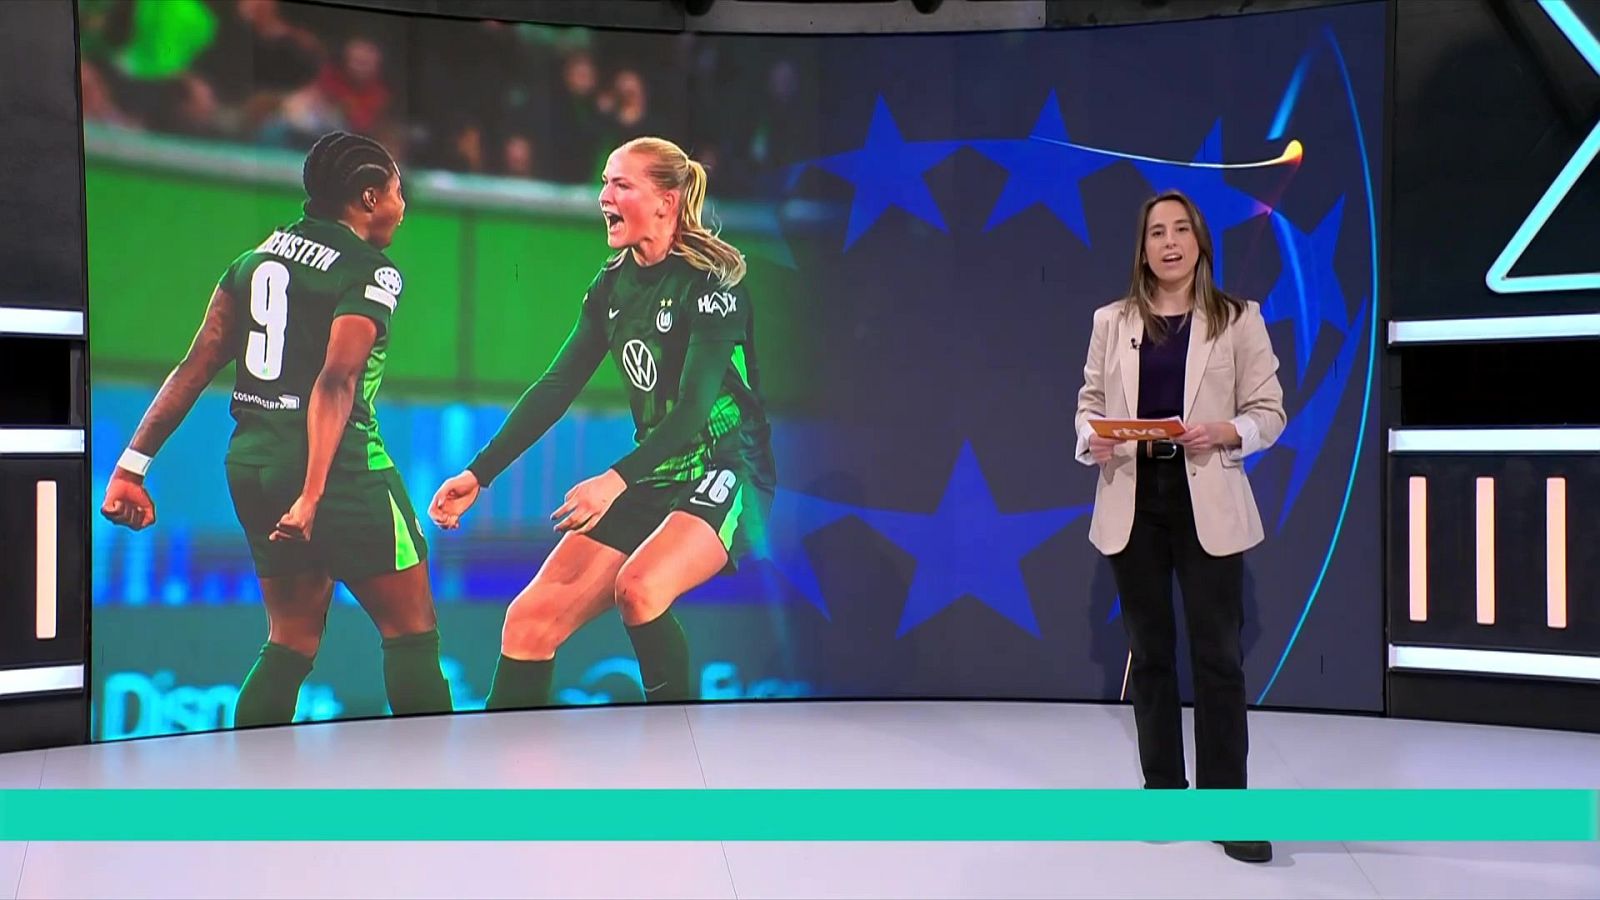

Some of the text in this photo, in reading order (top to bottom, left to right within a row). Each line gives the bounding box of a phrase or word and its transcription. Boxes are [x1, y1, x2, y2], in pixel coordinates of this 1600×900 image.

[245, 260, 290, 381] 9
[1111, 427, 1168, 437] rtve
[694, 469, 737, 504] 16
